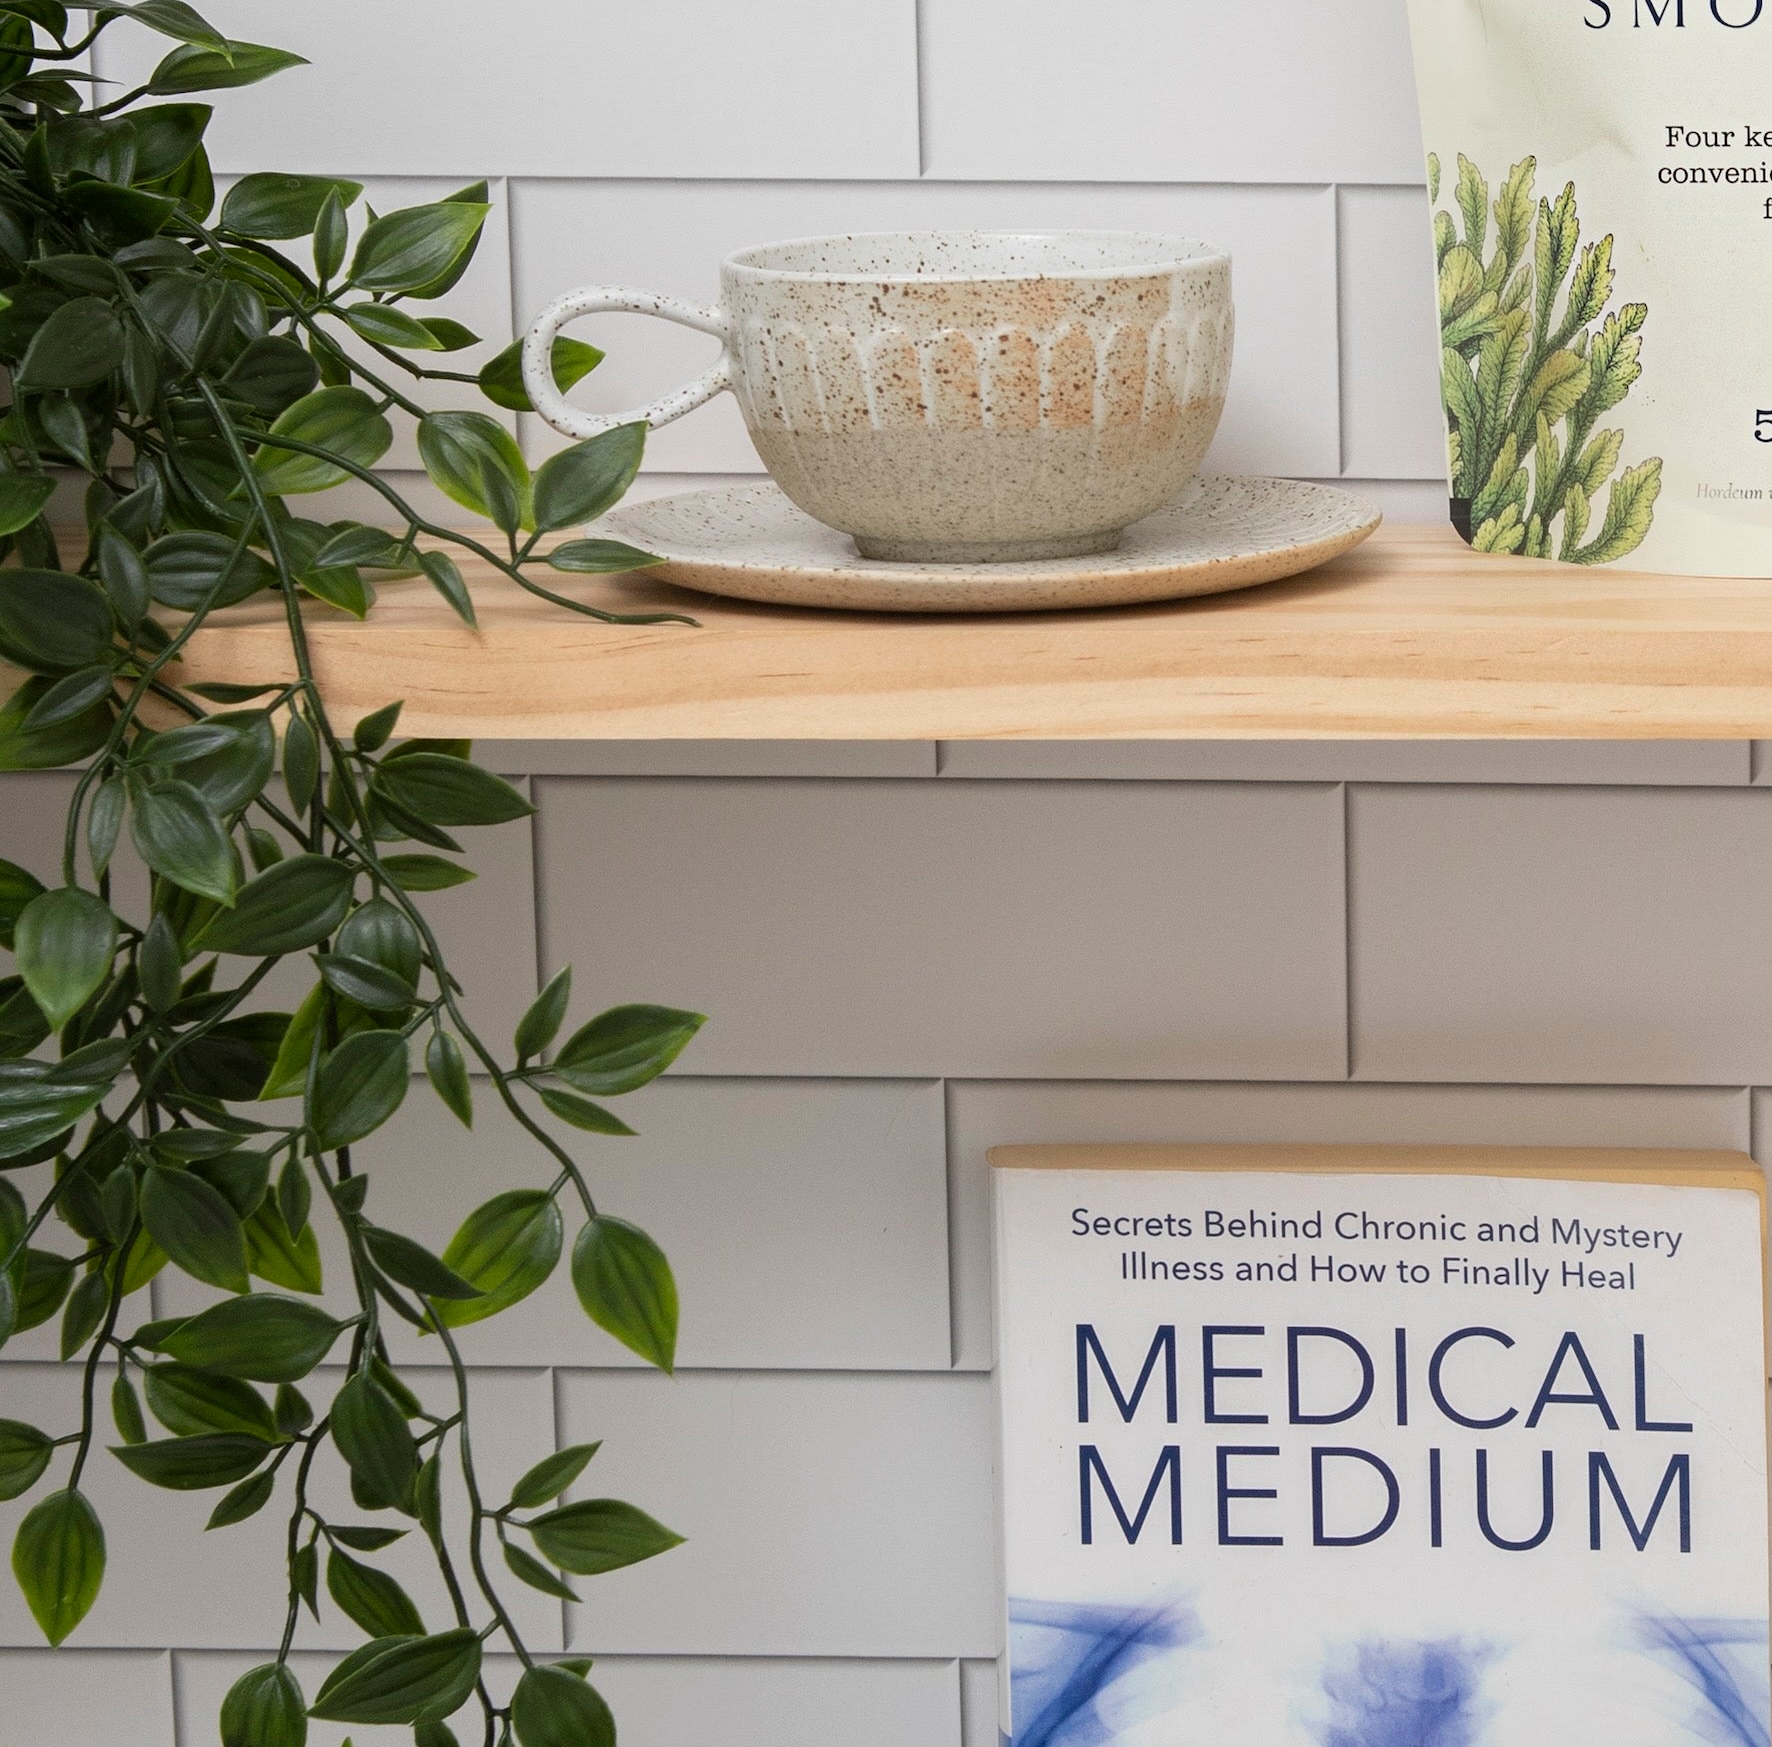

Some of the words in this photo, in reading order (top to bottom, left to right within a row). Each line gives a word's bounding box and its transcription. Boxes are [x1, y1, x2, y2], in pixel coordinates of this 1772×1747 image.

[1665, 125, 1736, 148] Four
[1696, 481, 1763, 500] Hordeum
[1071, 1207, 1193, 1238] Secrets
[1204, 1209, 1322, 1239] Behind
[1334, 1210, 1466, 1242] Chronic
[1477, 1215, 1539, 1244] and
[1551, 1217, 1683, 1258] Mystery
[1121, 1250, 1224, 1281] Illness
[1235, 1253, 1297, 1282] and
[1310, 1255, 1387, 1283] How
[1396, 1260, 1430, 1284] to
[1443, 1257, 1550, 1295] Finally
[1561, 1260, 1635, 1290] Heal
[1075, 1323, 1694, 1433] MEDICAL
[1078, 1444, 1691, 1554] MEDIUM
